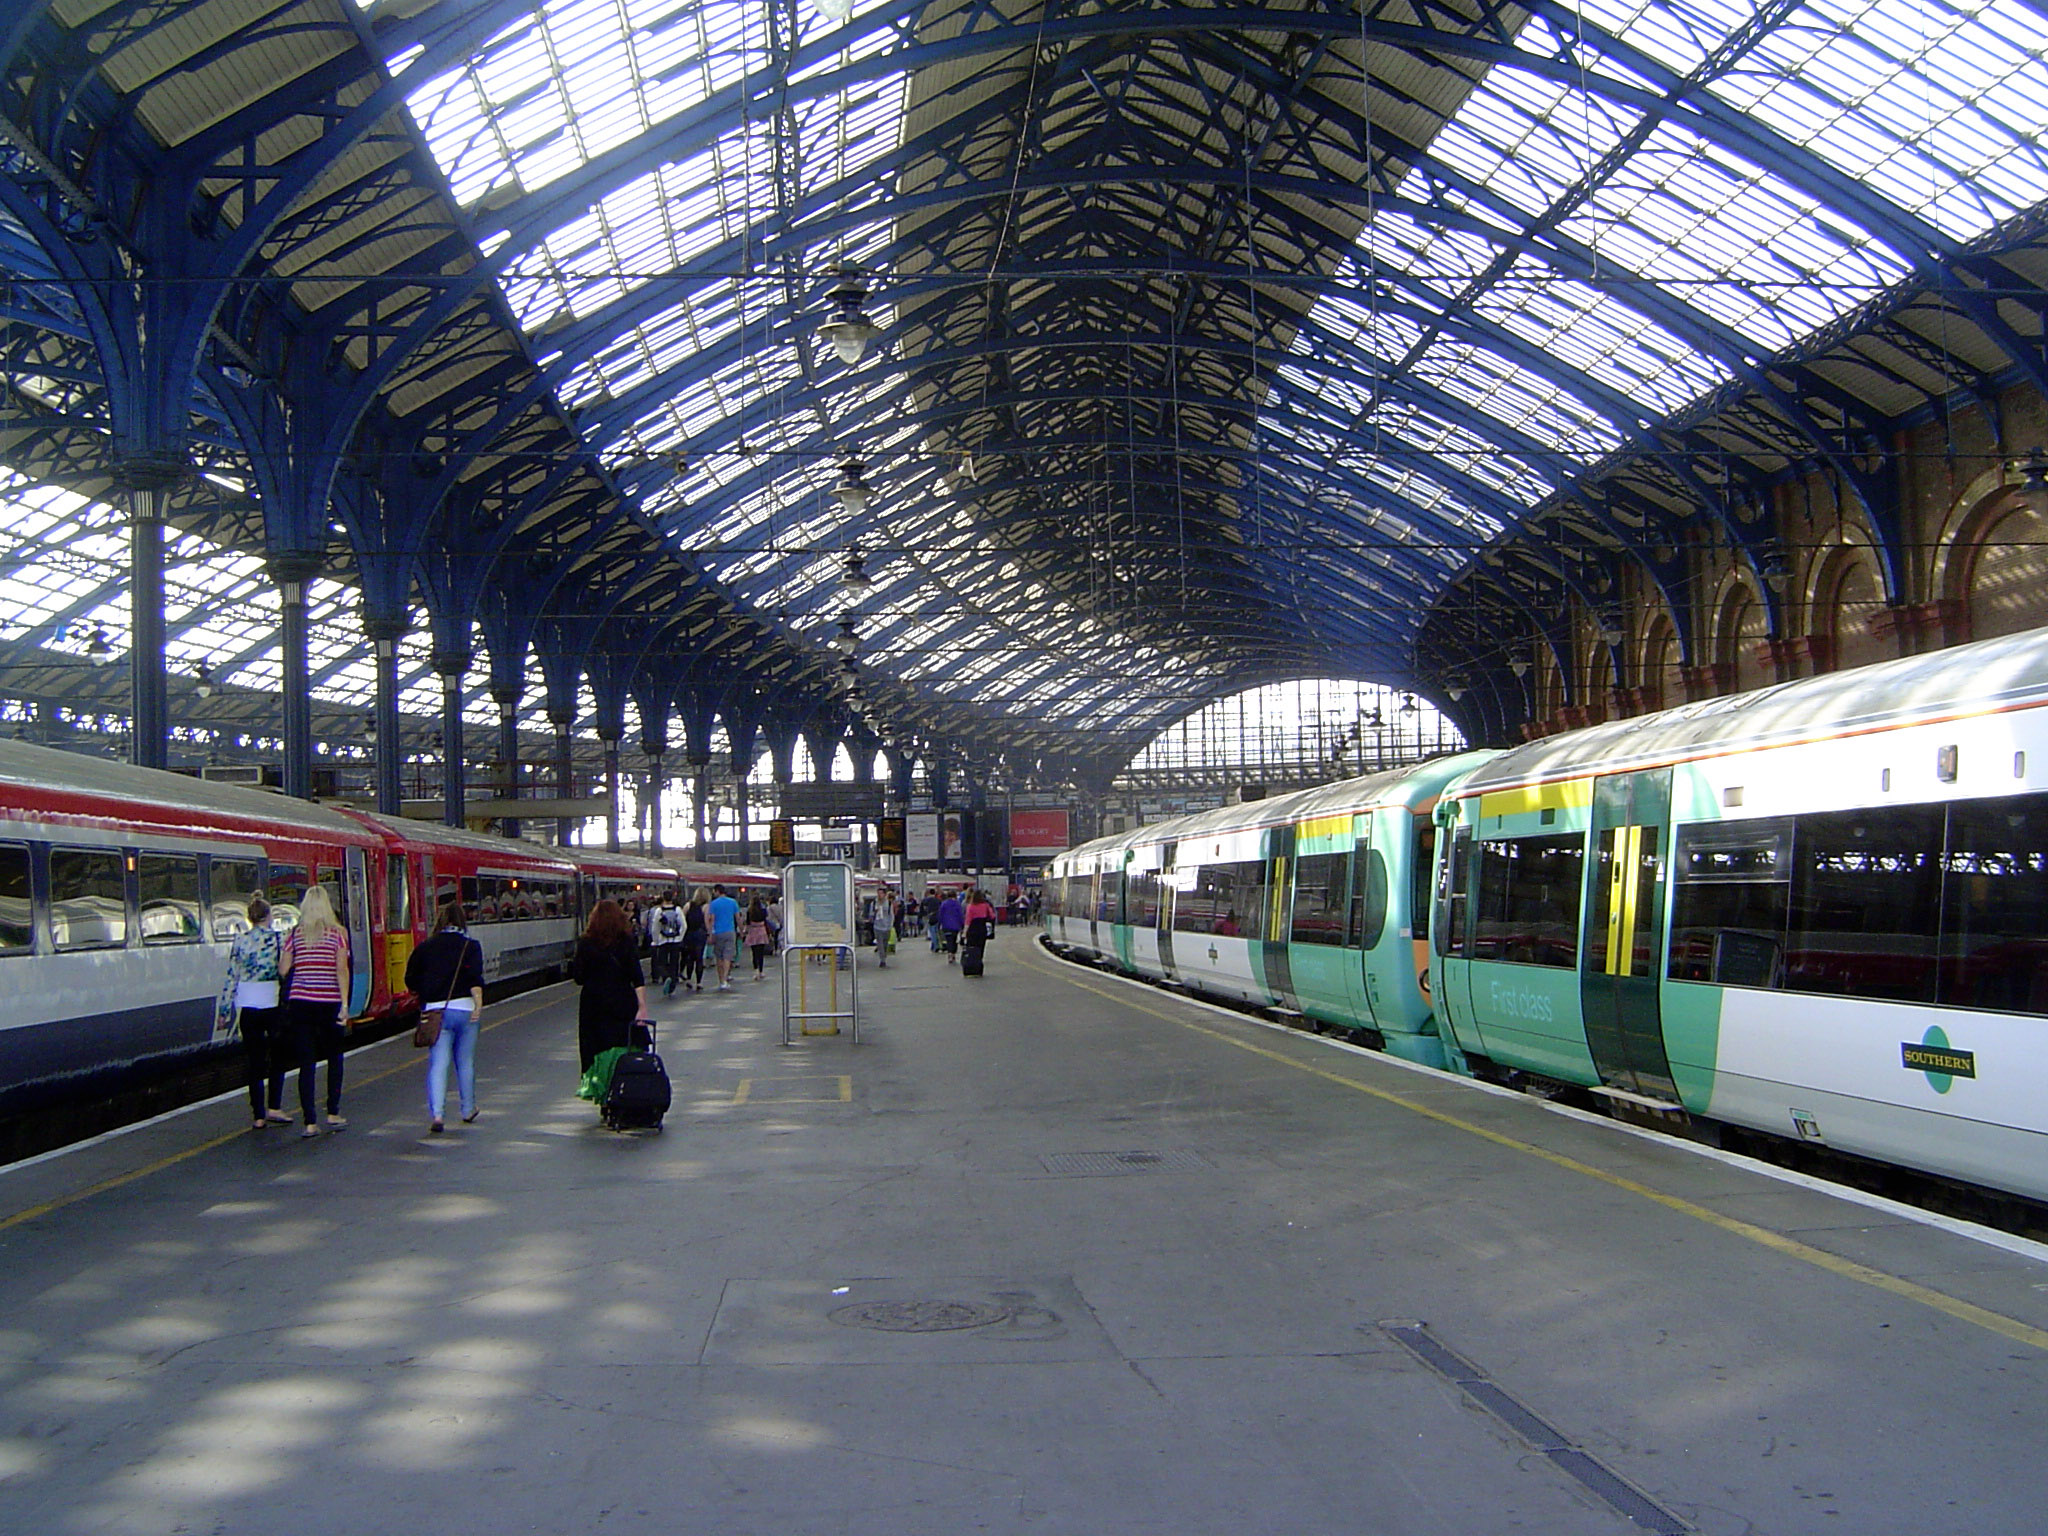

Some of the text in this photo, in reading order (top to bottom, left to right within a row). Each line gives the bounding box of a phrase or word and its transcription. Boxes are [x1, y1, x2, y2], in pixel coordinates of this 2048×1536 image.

[821, 845, 829, 857] 4
[844, 845, 851, 857] 3
[1491, 981, 1552, 1023] First class
[1903, 1050, 1971, 1070] SOUTHERN
